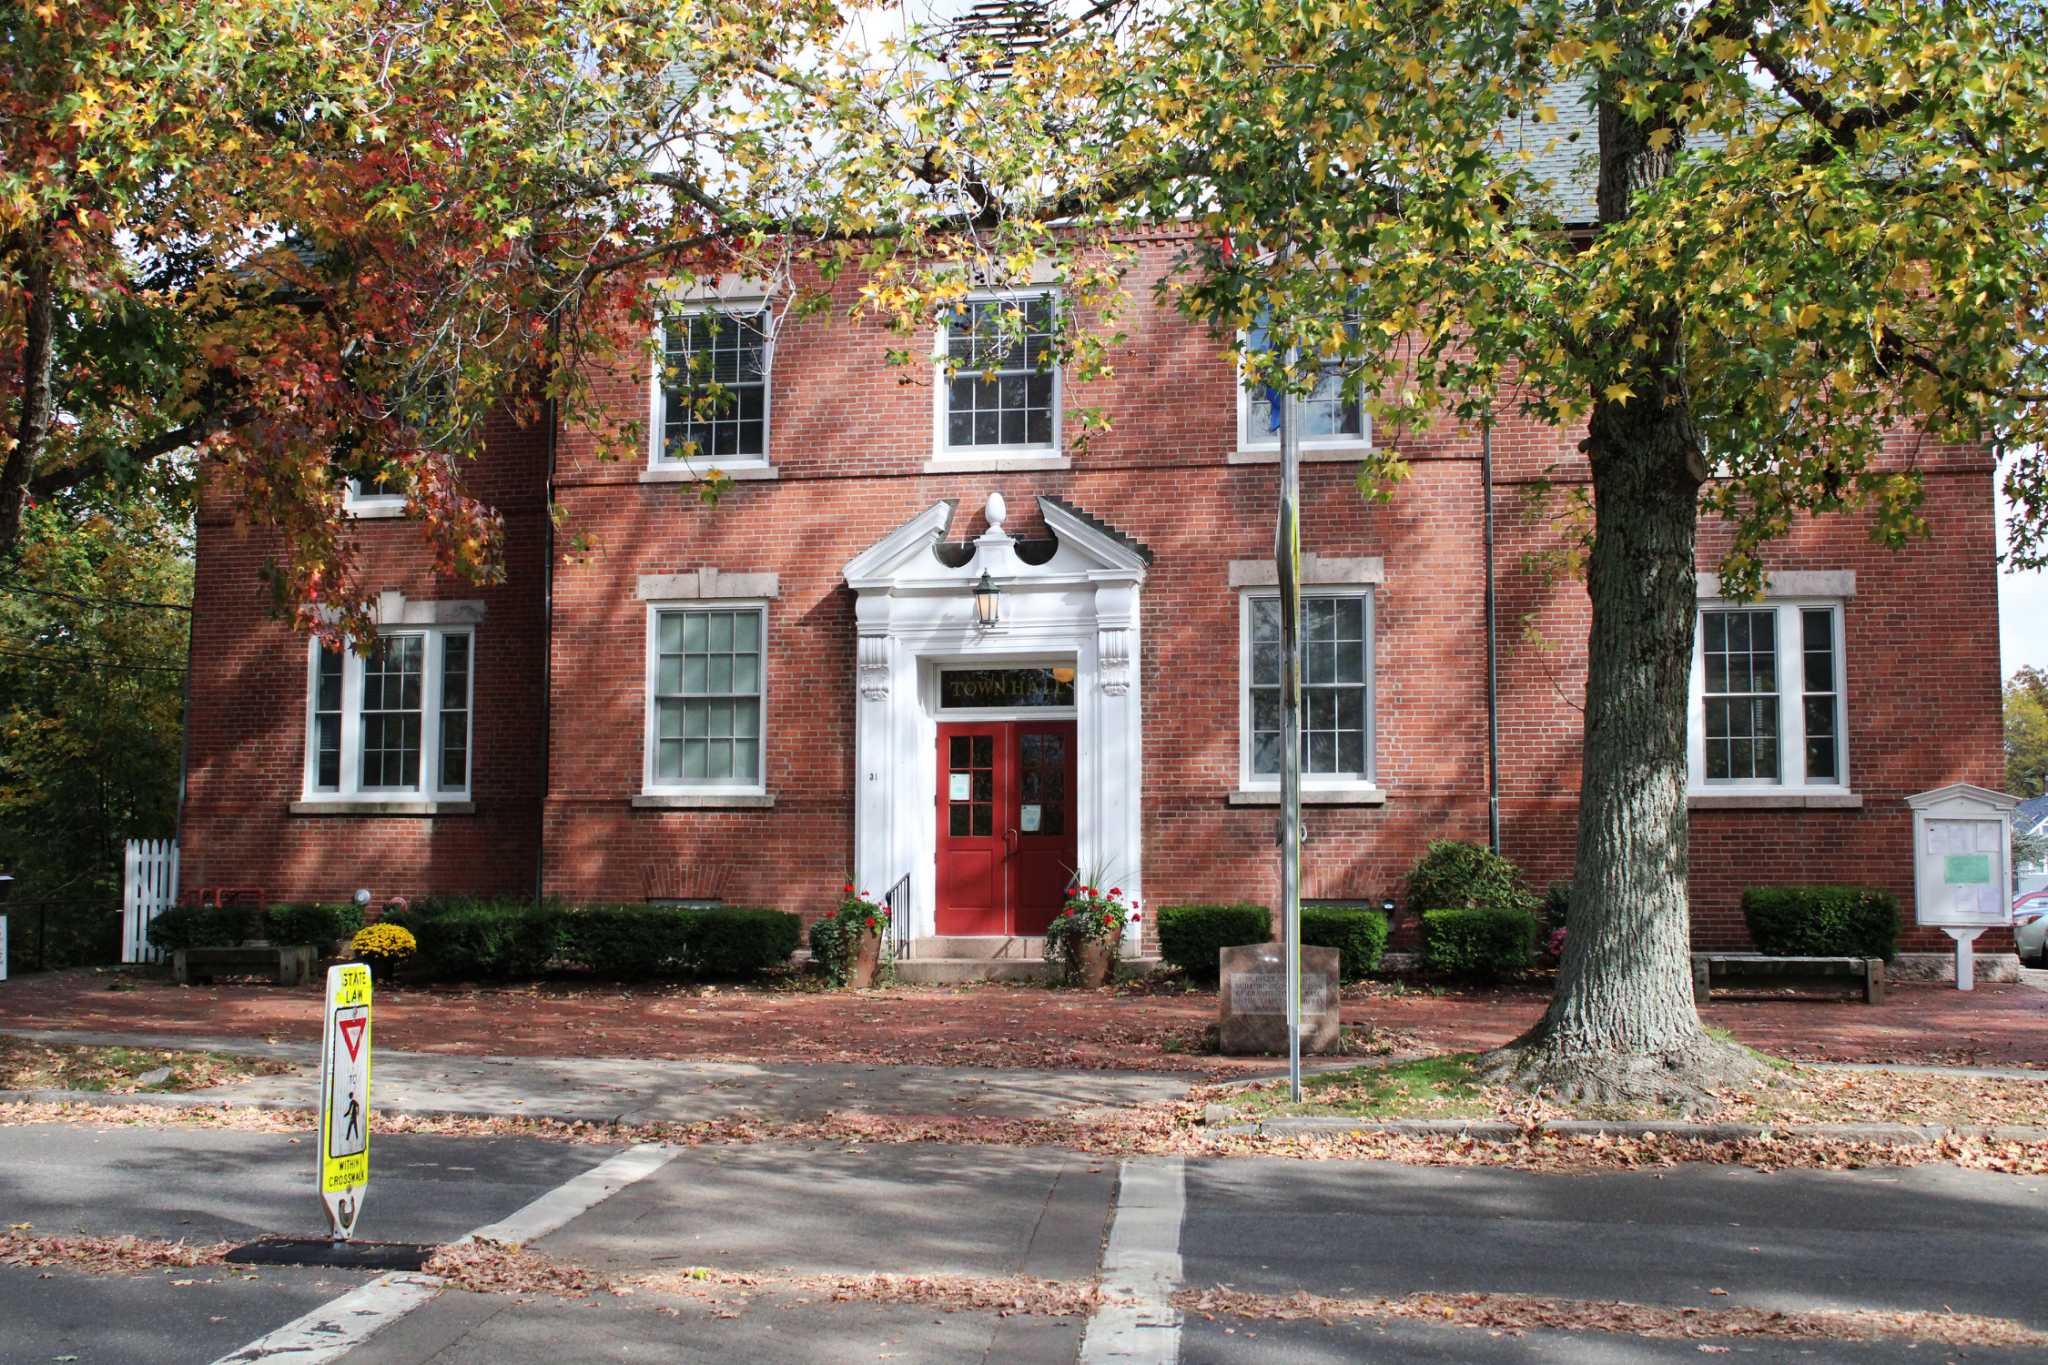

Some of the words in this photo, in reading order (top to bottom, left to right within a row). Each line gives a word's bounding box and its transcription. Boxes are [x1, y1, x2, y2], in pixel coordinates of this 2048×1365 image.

[951, 681, 1006, 697] TOWN
[1011, 680, 1066, 695] HALL
[868, 772, 878, 781] 31
[343, 972, 366, 986] STATE
[345, 990, 363, 1003] LAW
[339, 1159, 359, 1170] WITHIN
[329, 1171, 364, 1187] CROSSWALK
